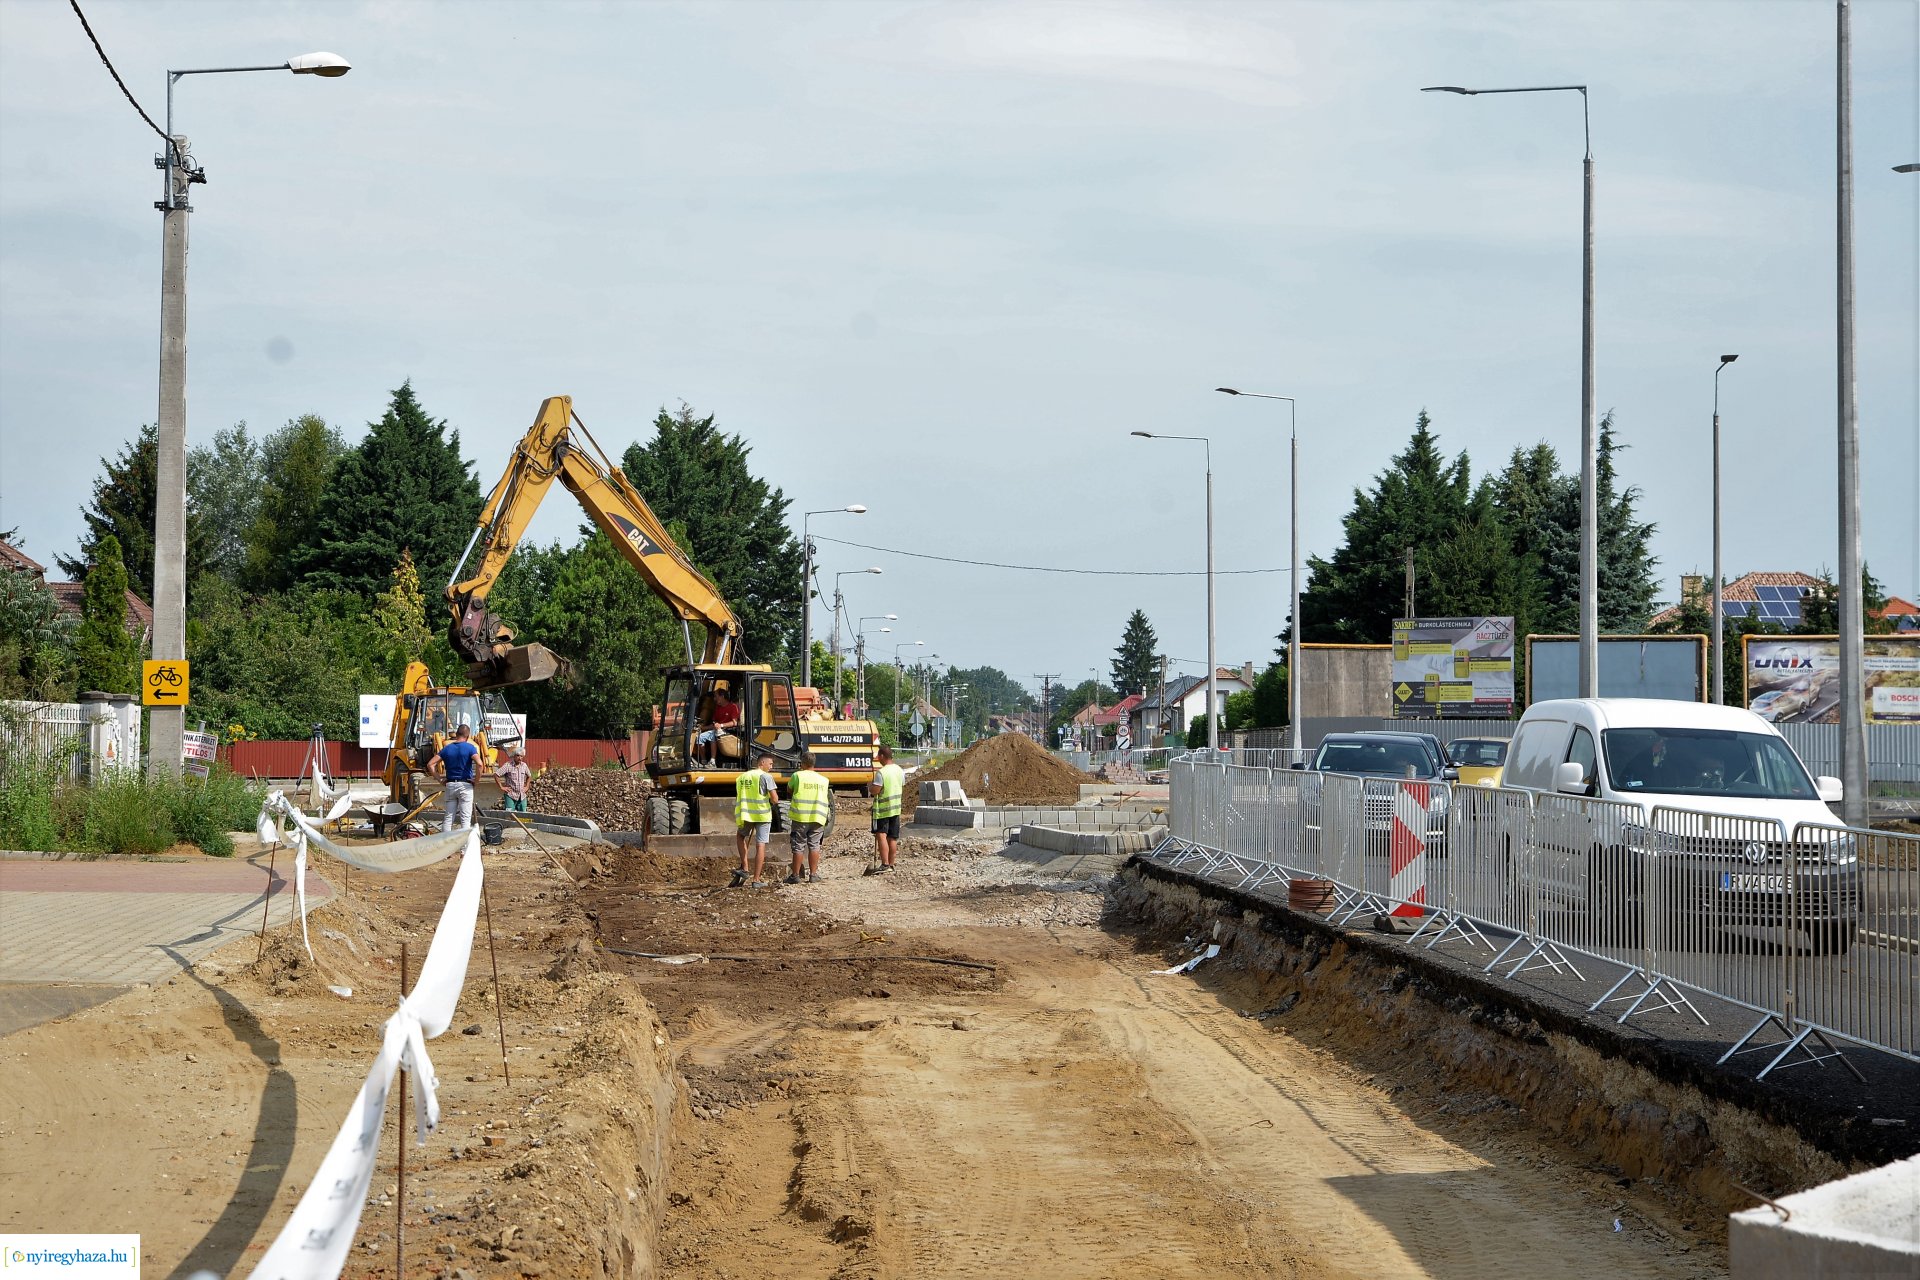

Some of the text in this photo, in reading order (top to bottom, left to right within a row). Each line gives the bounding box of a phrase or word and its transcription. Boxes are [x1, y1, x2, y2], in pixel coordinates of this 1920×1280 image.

[627, 528, 650, 552] CAT
[1754, 656, 1813, 669] UNIX
[1891, 694, 1919, 702] BOSCH
[845, 757, 871, 767] M318
